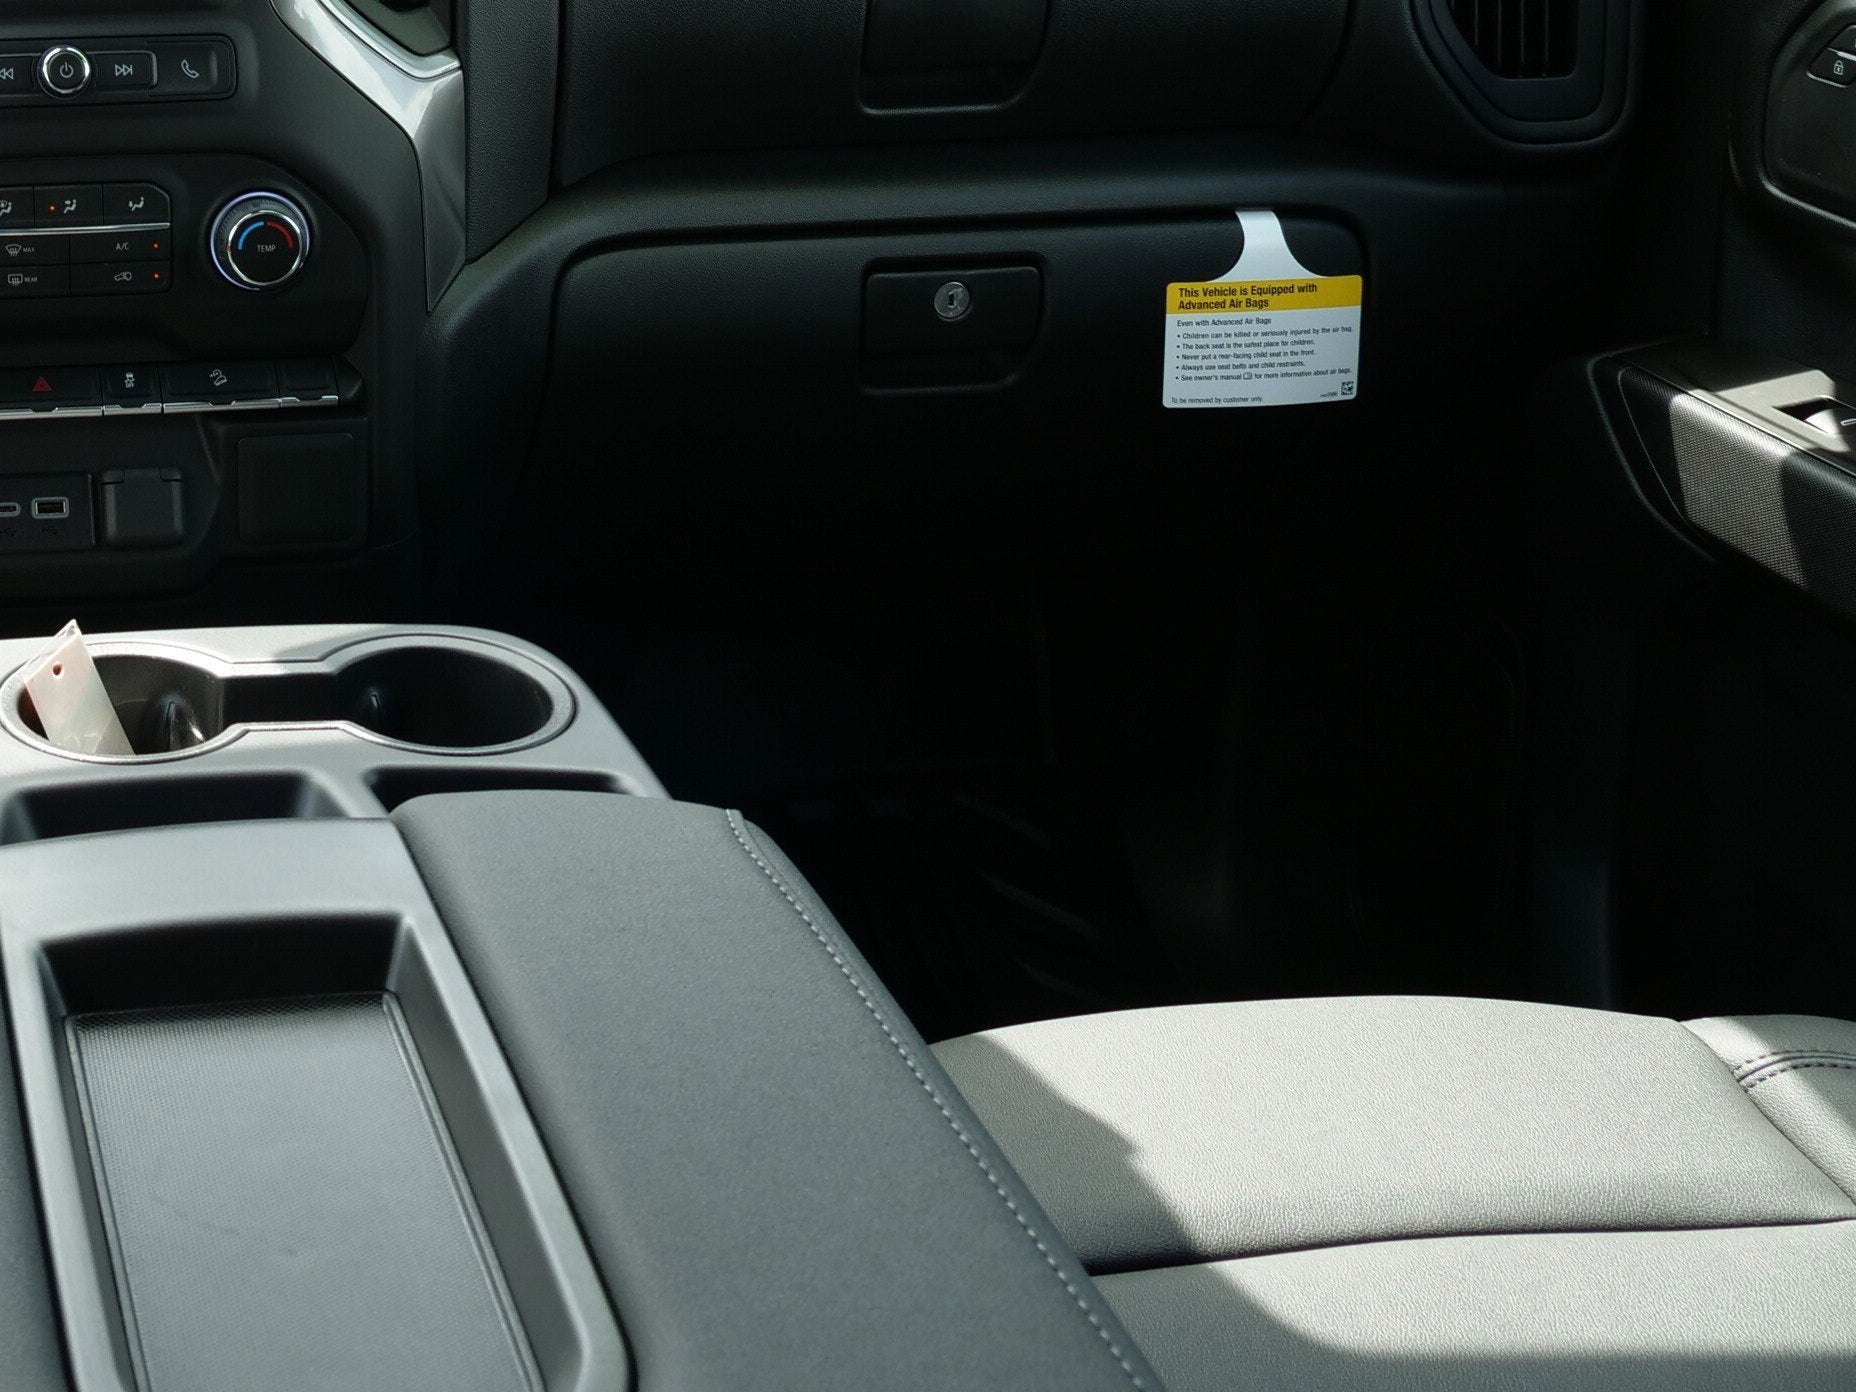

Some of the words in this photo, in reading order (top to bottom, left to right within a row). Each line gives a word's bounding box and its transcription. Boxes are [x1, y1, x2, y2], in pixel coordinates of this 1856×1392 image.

[116, 242, 129, 251] A/C
[257, 244, 276, 253] TEMP
[1179, 288, 1199, 298] This
[1202, 286, 1237, 297] Vehicle
[1239, 285, 1248, 296] is
[1251, 284, 1294, 297] Equipped
[1297, 283, 1317, 293] with
[1178, 299, 1226, 310] Advanced
[1229, 298, 1242, 309] Air
[1245, 298, 1269, 310] Bags
[1195, 319, 1210, 327] with
[1211, 319, 1243, 327] Advanced
[1255, 317, 1272, 326] Bags
[1182, 332, 1210, 340] Children
[1224, 331, 1232, 339] be
[1233, 330, 1251, 338] killed
[1260, 329, 1288, 338] seriously
[1290, 328, 1311, 337] injured
[1312, 328, 1319, 336] by
[1340, 326, 1353, 334] bag.
[1263, 340, 1279, 348] place
